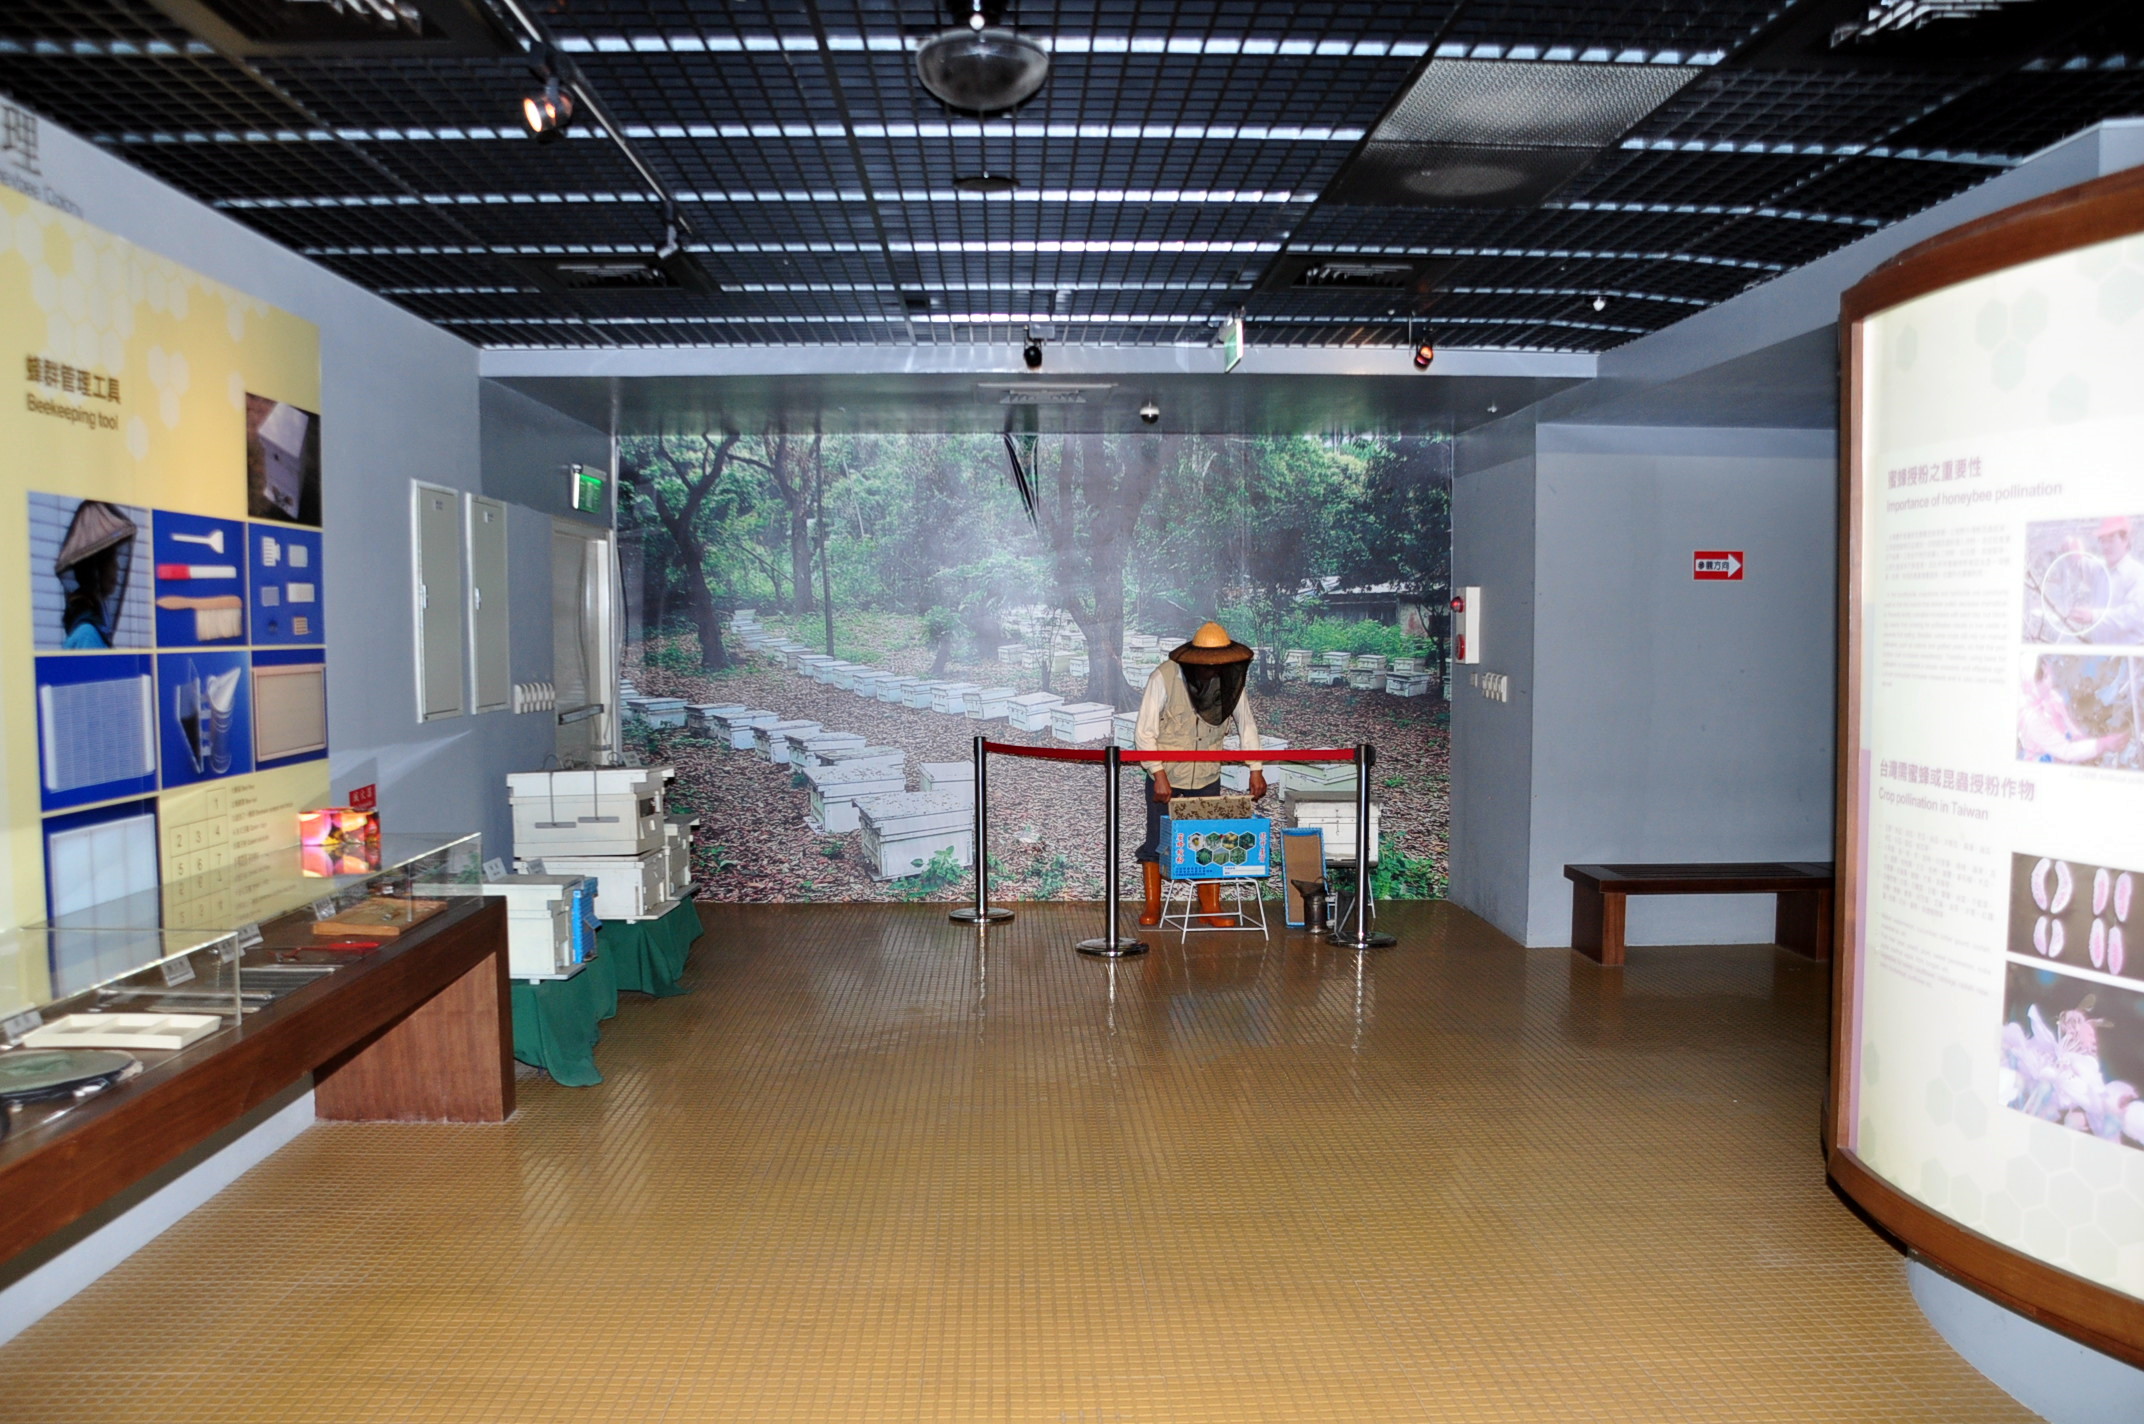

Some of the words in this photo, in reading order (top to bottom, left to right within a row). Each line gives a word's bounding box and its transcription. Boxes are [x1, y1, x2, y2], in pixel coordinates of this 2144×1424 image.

[26, 392, 96, 430] Beekeeping
[98, 411, 119, 430] tool
[1887, 456, 1982, 490] 蜜蜂授粉之重要性
[1931, 493, 1941, 507] of
[1942, 489, 1993, 507] honeybee
[1995, 482, 2063, 504] pollination
[1879, 758, 2036, 802] 台灣需蜜蜂或昆蟲授粉作物
[1878, 786, 1896, 804] Crop
[1896, 791, 1938, 811] pollination
[1940, 799, 1949, 814] in
[1951, 801, 1989, 821] Taiwan
